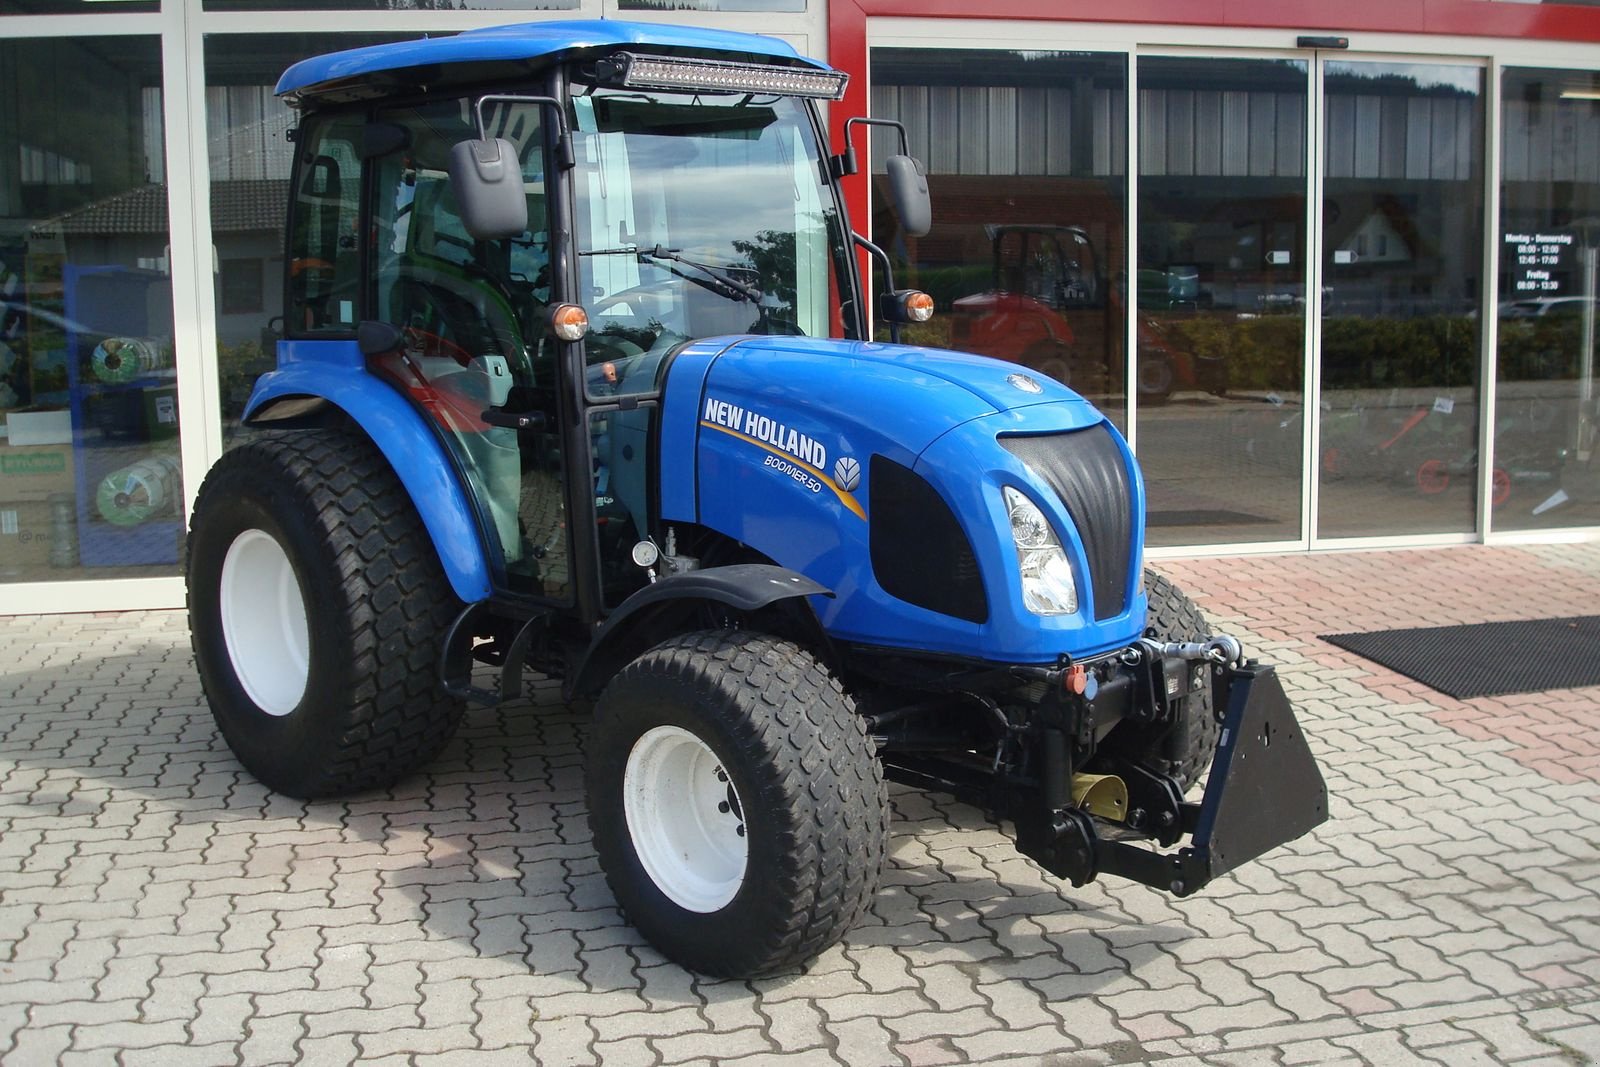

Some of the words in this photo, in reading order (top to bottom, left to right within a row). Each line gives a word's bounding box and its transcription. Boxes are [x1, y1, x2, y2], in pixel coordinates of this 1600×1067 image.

[1505, 233, 1530, 244] Montag
[1535, 234, 1572, 245] Donnerstag
[1542, 245, 1559, 254] 12:00
[1519, 256, 1536, 264] 12:45
[1541, 256, 1558, 264] 17:00
[1526, 270, 1550, 280] Freitag
[705, 398, 744, 431] NEW
[745, 411, 826, 470] HOLLAND
[764, 455, 807, 486] BOOMER
[806, 478, 822, 493] 50
